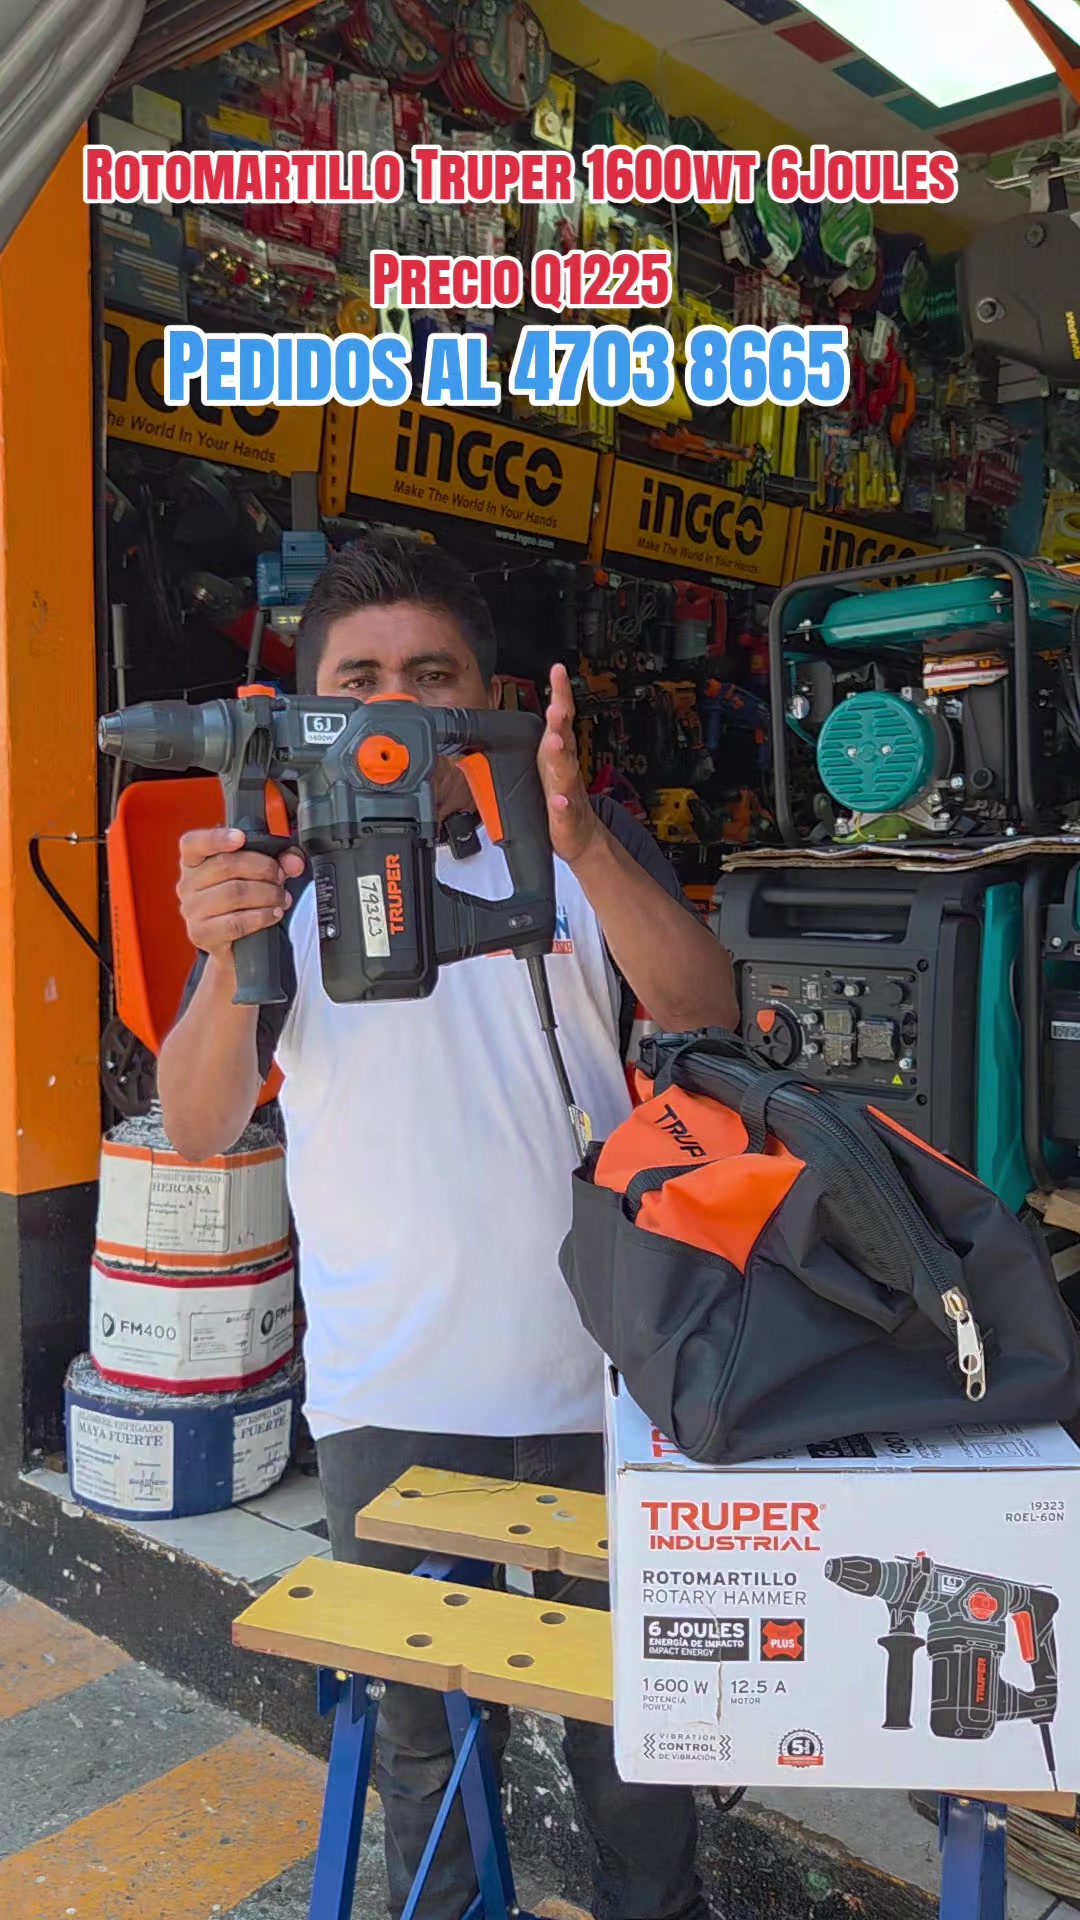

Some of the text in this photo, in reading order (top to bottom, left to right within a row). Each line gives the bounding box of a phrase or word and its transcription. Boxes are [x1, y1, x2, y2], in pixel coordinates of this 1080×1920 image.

[107, 410, 276, 463] he World In Your Hands
[394, 480, 558, 529] Make The World In Your Hands
[496, 529, 555, 550] www.ingco.com
[637, 536, 660, 553] Make
[662, 542, 678, 556] The
[680, 548, 704, 563] World
[705, 552, 714, 564] In
[313, 717, 332, 732] 6J
[386, 853, 405, 936] TRUPER
[152, 1182, 211, 1195] HERCASA
[120, 1320, 177, 1341] FM400
[79, 1422, 163, 1447] MAYA FUERTE
[1031, 1501, 1065, 1511] 19323
[641, 1501, 820, 1531] TRUPER
[1005, 1512, 1064, 1522] ROEL-60N
[649, 1535, 820, 1551] INDUSTRIAL
[643, 1570, 797, 1586] ROTOMARTILLO
[643, 1588, 807, 1606] ROTARY HAMMER
[648, 1620, 745, 1638] 6 JOULES
[649, 1637, 745, 1648] ENERGÍA DE IMPACTO
[770, 1639, 796, 1649] PLUS
[649, 1647, 715, 1657] IMPACT ENERGY
[694, 1680, 709, 1695] W
[731, 1680, 787, 1694] 12.5 A
[975, 1657, 988, 1704] TRUPER
[643, 1695, 687, 1704] POTENCIA
[731, 1697, 761, 1705] MOTOR
[659, 1733, 716, 1741] VIBRATION
[658, 1742, 716, 1752] CONTROL
[792, 1740, 804, 1755] 5
[672, 1752, 716, 1761] VIBRACIÓN
